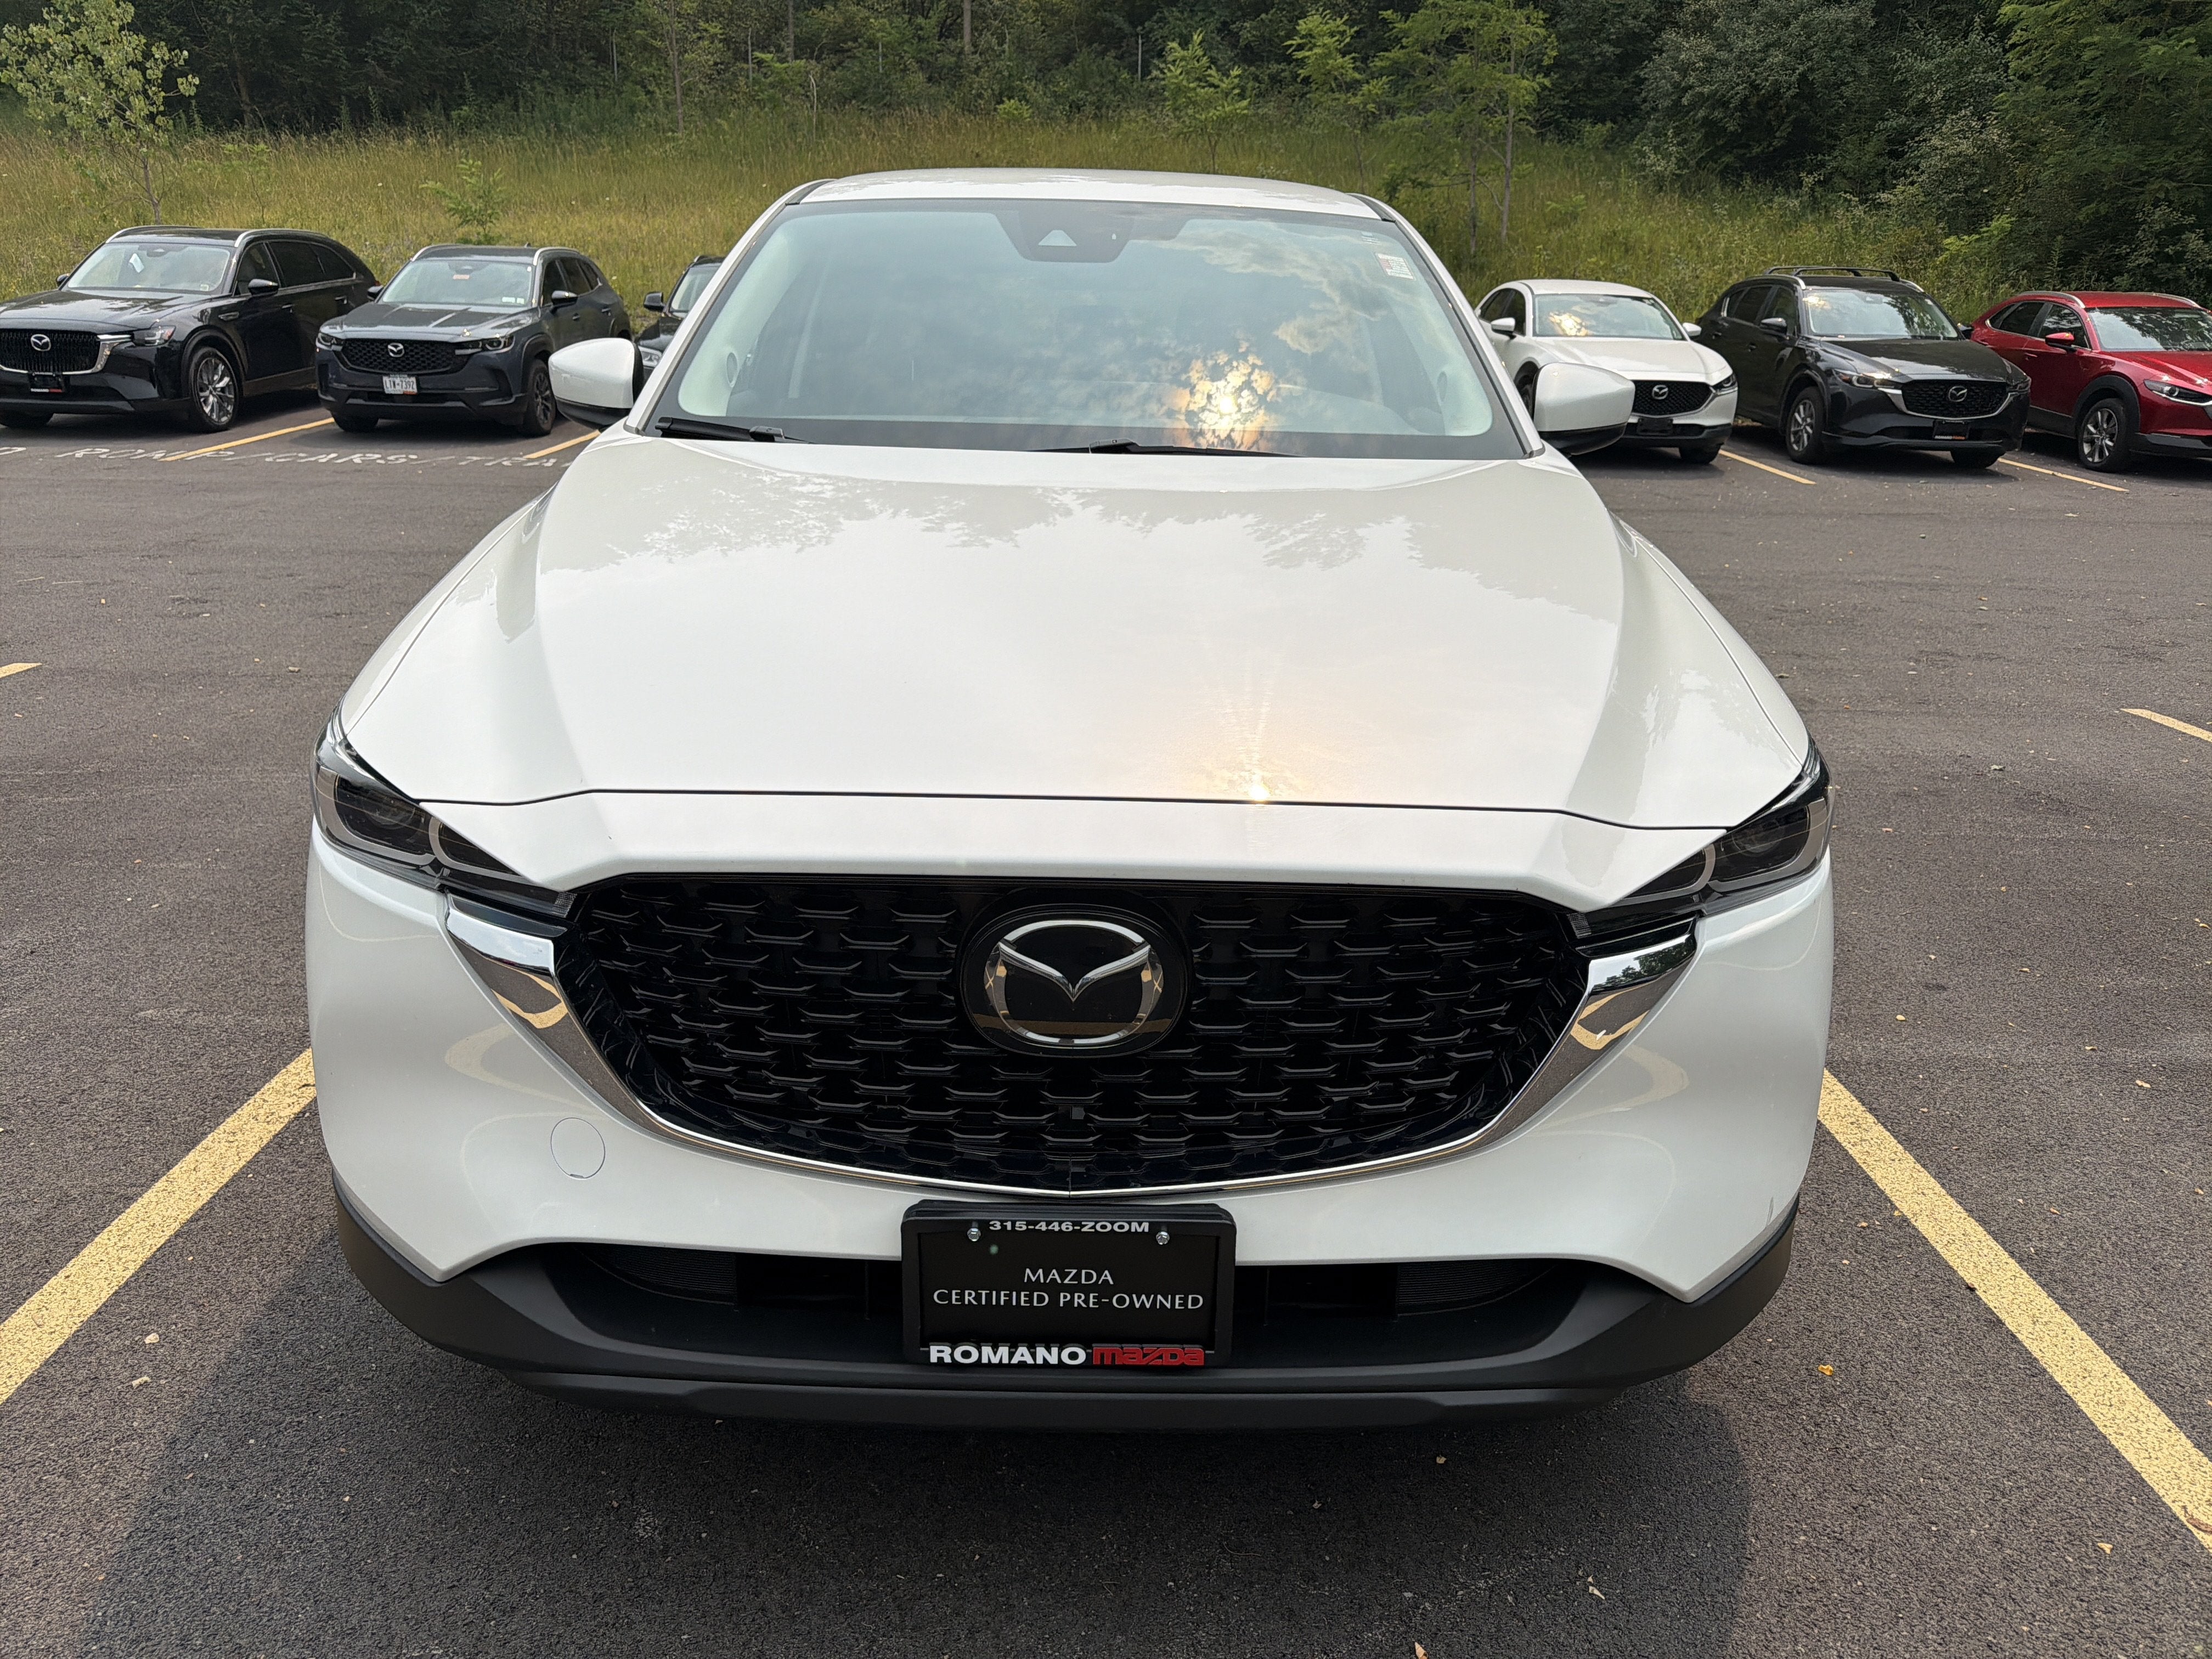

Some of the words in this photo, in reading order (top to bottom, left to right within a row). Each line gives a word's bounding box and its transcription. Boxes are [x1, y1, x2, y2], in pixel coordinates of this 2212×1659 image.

[989, 1221, 1149, 1233] 315-446-ZOOM
[1023, 1268, 1114, 1285] MAZDA
[933, 1289, 1049, 1307] CERTIFIED
[1059, 1293, 1204, 1310] PRE-OWNED
[929, 1345, 1087, 1365] ROMANO
